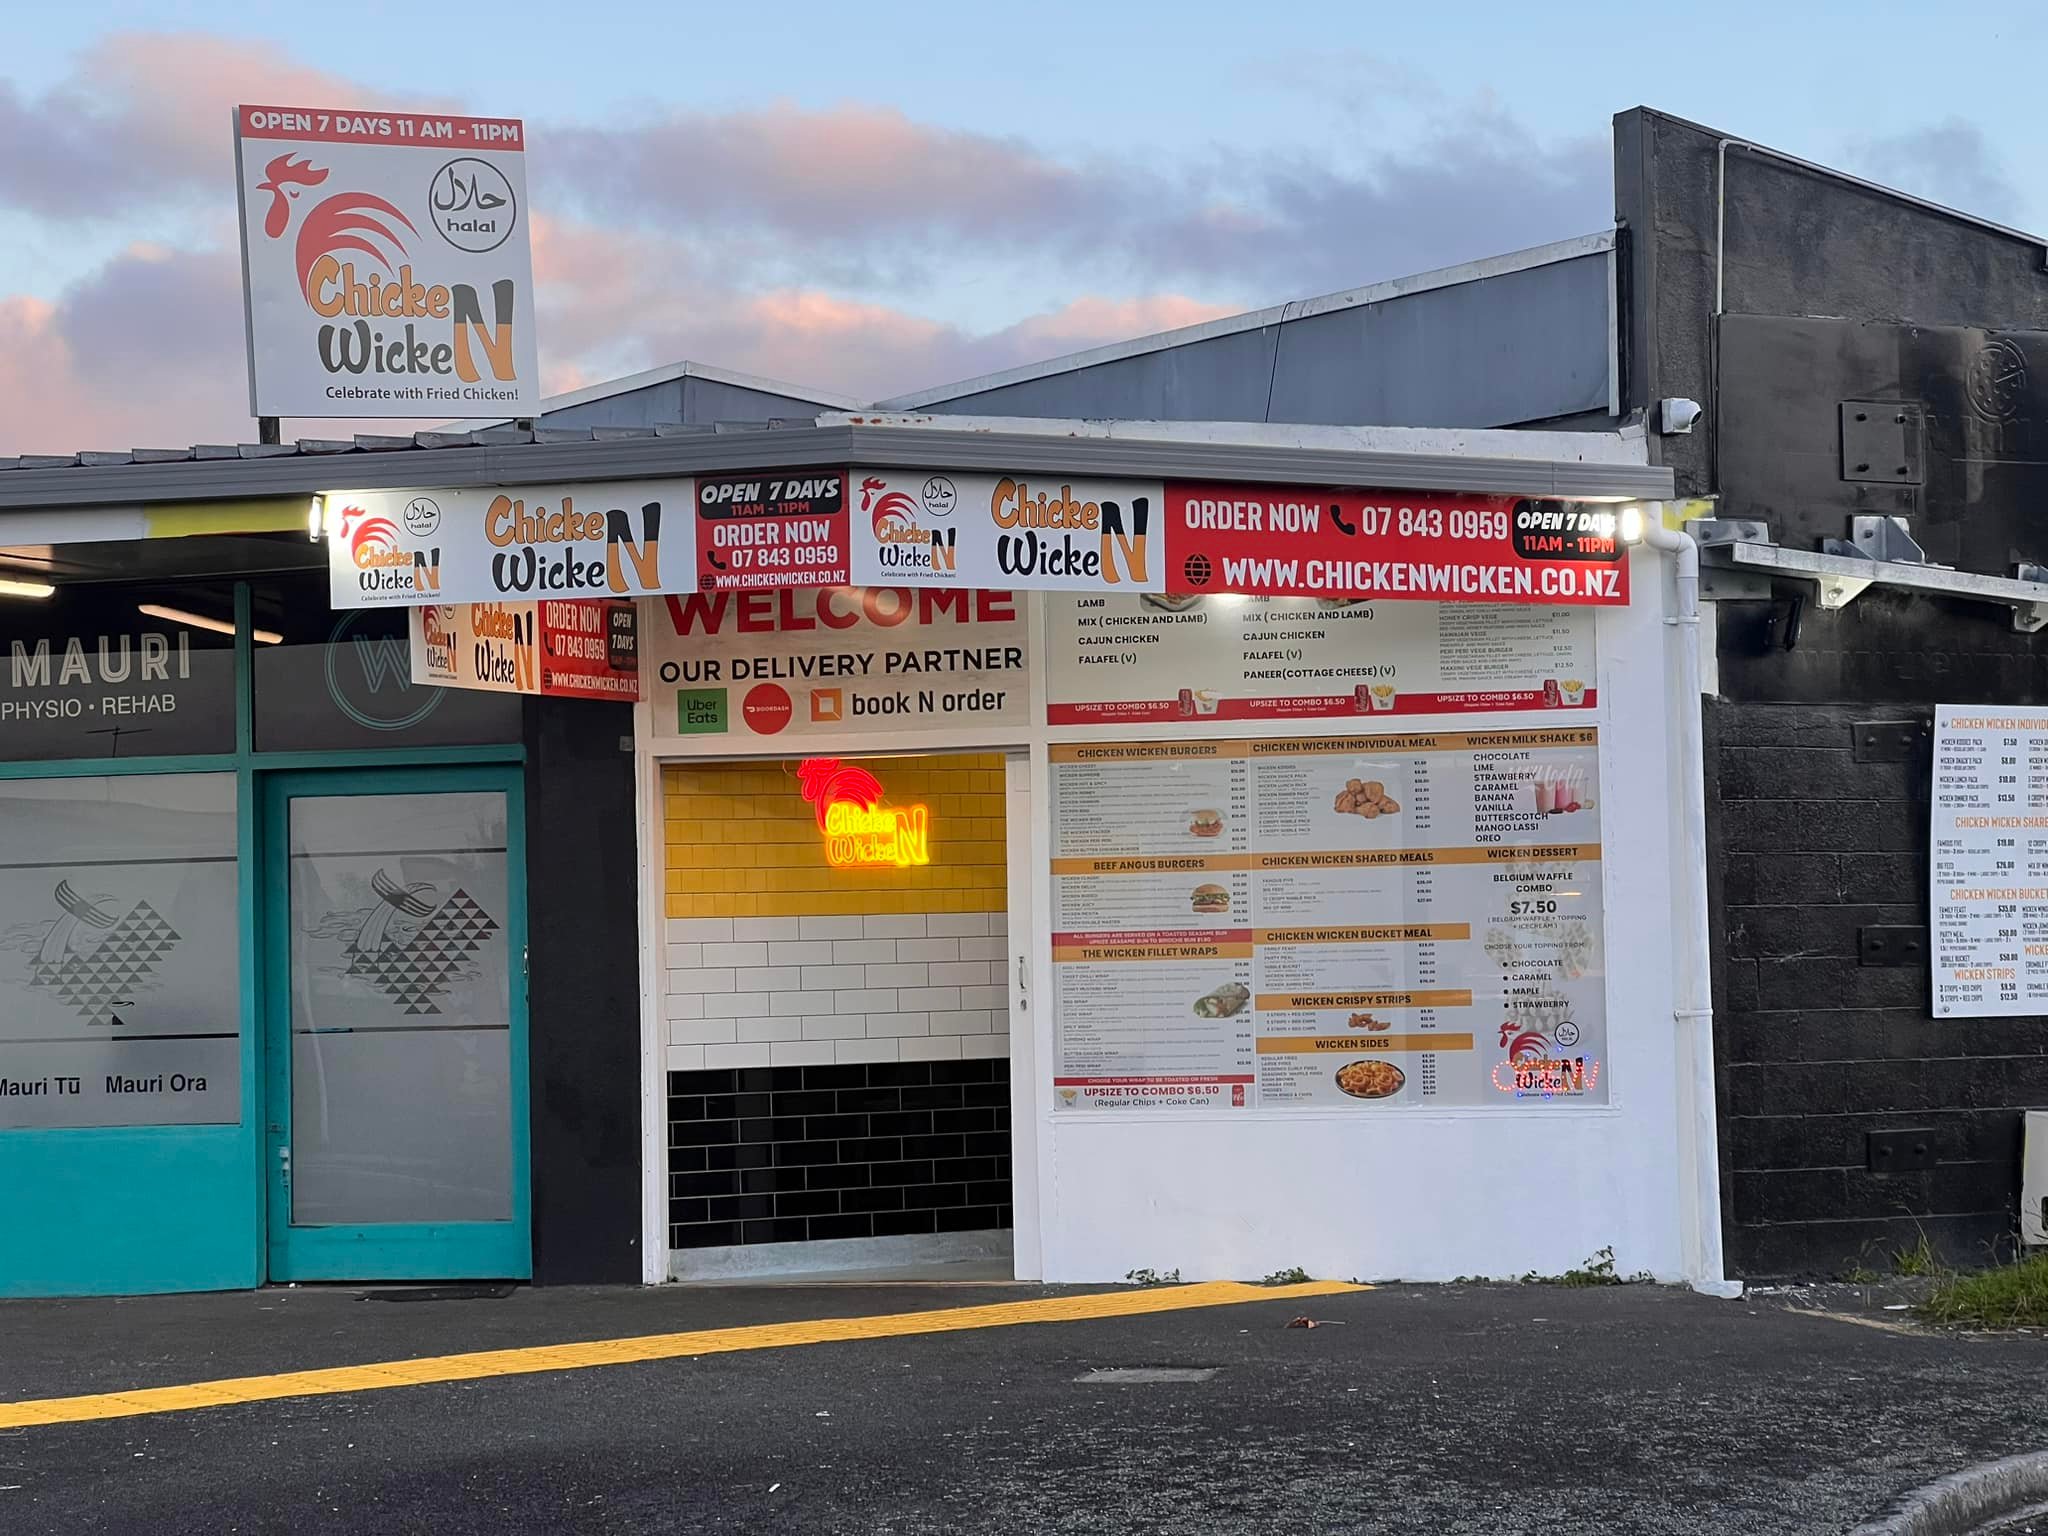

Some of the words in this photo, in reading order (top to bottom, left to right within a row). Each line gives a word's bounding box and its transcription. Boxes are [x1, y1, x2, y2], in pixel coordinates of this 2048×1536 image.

[251, 112, 310, 131] OPEN
[318, 116, 329, 132] 7
[336, 117, 391, 136] DAYS
[397, 120, 414, 136] 11
[421, 121, 452, 138] AM
[472, 124, 519, 141] 11PM
[434, 167, 506, 211] حلال
[448, 219, 495, 233] halal
[326, 387, 390, 399] Celebrate
[394, 388, 423, 399] with
[427, 388, 460, 399] Fried
[463, 389, 519, 400] Chicken!
[701, 483, 760, 503] OPEN
[770, 482, 782, 500] 7
[785, 479, 840, 499] DAYS
[731, 504, 764, 516] 11AM
[778, 502, 809, 513] 11PM
[1186, 500, 1262, 532] ORDER
[1270, 503, 1320, 533] NOW
[1362, 507, 1391, 535] 07
[1398, 509, 1443, 537] 843
[1450, 511, 1507, 540] 0959
[1517, 512, 1564, 529] OPEN
[1567, 513, 1577, 531] 7
[714, 523, 779, 546] ORDER
[785, 520, 830, 543] NOW
[1523, 536, 1562, 551] 11AM
[1578, 537, 1615, 553] 11PM
[732, 550, 753, 568] 07
[758, 548, 789, 566] 843
[795, 546, 837, 564] 0959
[716, 570, 846, 588] WWW.CHICKENWICKEN.CO.NZ
[1223, 558, 1620, 598] WWW.CHICKENWICKEN.CO.NZ
[1078, 599, 1104, 607] LAMB
[664, 587, 1015, 635] WELCOME
[1243, 614, 1261, 622] MIX
[1271, 611, 1315, 621] CHICKEN
[1318, 610, 1339, 619] AND
[1341, 608, 1373, 620] LAMB)
[547, 602, 577, 631] ORDER
[580, 606, 601, 633] NOW
[613, 613, 632, 628] OPEN
[1078, 618, 1096, 626] MIX
[1106, 616, 1149, 625] CHICKEN
[1152, 616, 1173, 624] AND
[1175, 613, 1208, 624] LAMB)
[1079, 636, 1113, 645] CAJUN
[1115, 635, 1159, 644] CHICKEN
[1243, 632, 1277, 641] CAJUN
[1280, 631, 1325, 639] CHICKEN
[555, 634, 566, 657] 07
[568, 636, 583, 659] 843
[585, 638, 605, 660] 0959
[612, 635, 617, 648] 7
[618, 635, 633, 650] DAYS
[11, 631, 190, 687] MAURI
[1079, 655, 1118, 664] FALAFEL
[1121, 653, 1136, 664] (V)
[1244, 651, 1284, 660] FALAFEL
[1287, 650, 1302, 660] (V)
[660, 659, 721, 683] OUR
[732, 653, 876, 680] DELIVERY
[885, 648, 1022, 674] PARTNER
[1244, 668, 1334, 680] PANEER(COTTAGE
[1336, 666, 1377, 678] CHEESE)
[1380, 665, 1395, 677] (V)
[552, 673, 638, 693] WWW.CHICKENWICKEN.CO.NZ
[853, 692, 910, 715] book
[918, 691, 933, 713] N
[942, 689, 1006, 712] order
[1480, 693, 1510, 701] COMBO
[2, 699, 81, 720] PHYSIO
[102, 694, 176, 715] REHAB
[687, 699, 716, 711] Uber
[687, 712, 717, 724] Eats
[1467, 736, 1510, 745] WICKEN
[1512, 735, 1536, 744] MILK
[1540, 734, 1575, 743] SHAKE
[1580, 733, 1592, 742] $6
[1253, 743, 1299, 752] CHICKEN
[1302, 742, 1344, 751] WICKEN
[1347, 740, 1407, 749] INDIVIDUAL
[1410, 739, 1436, 747] MEAL
[1077, 749, 1124, 758] CHICKEN
[1126, 748, 1168, 757] WICKEN
[1171, 746, 1217, 755] BURGERS
[1473, 752, 1530, 761] CHOCOLATE
[1474, 773, 1536, 781] STRAWBERRY
[1474, 783, 1518, 791] CARAMEL
[1475, 804, 1513, 812] VANILLA
[1475, 813, 1548, 822] BUTTERSCOTCH
[1956, 817, 1989, 827] CHICKEN
[1991, 817, 2020, 827] WICKEN
[1475, 824, 1511, 832] MANGO
[1514, 823, 1538, 831] LASSI
[1262, 856, 1308, 865] CHICKEN
[1311, 855, 1353, 864] WICKEN
[1356, 854, 1397, 863] SHARED
[1400, 853, 1434, 862] MEALS
[1488, 850, 1531, 858] WICKEN
[1533, 848, 1578, 856] DESSERT
[1094, 861, 1117, 870] BEEF
[1120, 860, 1156, 869] ANGUS
[1158, 859, 1204, 868] BURGERS
[1494, 874, 1534, 882] BELGIUM
[1951, 889, 1984, 900] CHICKEN
[1986, 889, 2016, 900] WICKEN
[1511, 900, 1556, 914] $7.50
[1268, 932, 1313, 941] CHICKEN
[1316, 931, 1359, 940] WICKEN
[1361, 930, 1401, 939] BUCKET
[1404, 929, 1432, 937] MEAL
[1082, 950, 1101, 958] THE
[1103, 949, 1145, 958] WICKEN
[1148, 948, 1178, 957] FILLET
[1181, 947, 1218, 956] WRAPS
[1512, 960, 1563, 968] CHOCOLATE
[1955, 969, 1985, 980] WICKEN
[1986, 969, 2015, 980] STRIPS
[1292, 997, 1334, 1006] WICKEN
[1336, 996, 1372, 1005] CRISPY
[1375, 995, 1411, 1004] STRIPS
[1513, 1001, 1570, 1009] STRAWBERRY
[1316, 1040, 1358, 1049] WICKEN
[1360, 1039, 1389, 1048] SIDES
[0, 1078, 47, 1096] Mauri
[106, 1075, 162, 1093] Mauri
[170, 1074, 207, 1092] Ora
[1084, 1088, 1121, 1096] UPSIZE
[1126, 1088, 1139, 1096] TO
[1142, 1087, 1184, 1096] COMBO
[1188, 1086, 1219, 1094] $6.50
[1095, 1098, 1133, 1107] (Regular
[1137, 1098, 1156, 1107] Chips
[1167, 1098, 1187, 1106] Coke
[1191, 1097, 1209, 1106] Can)
